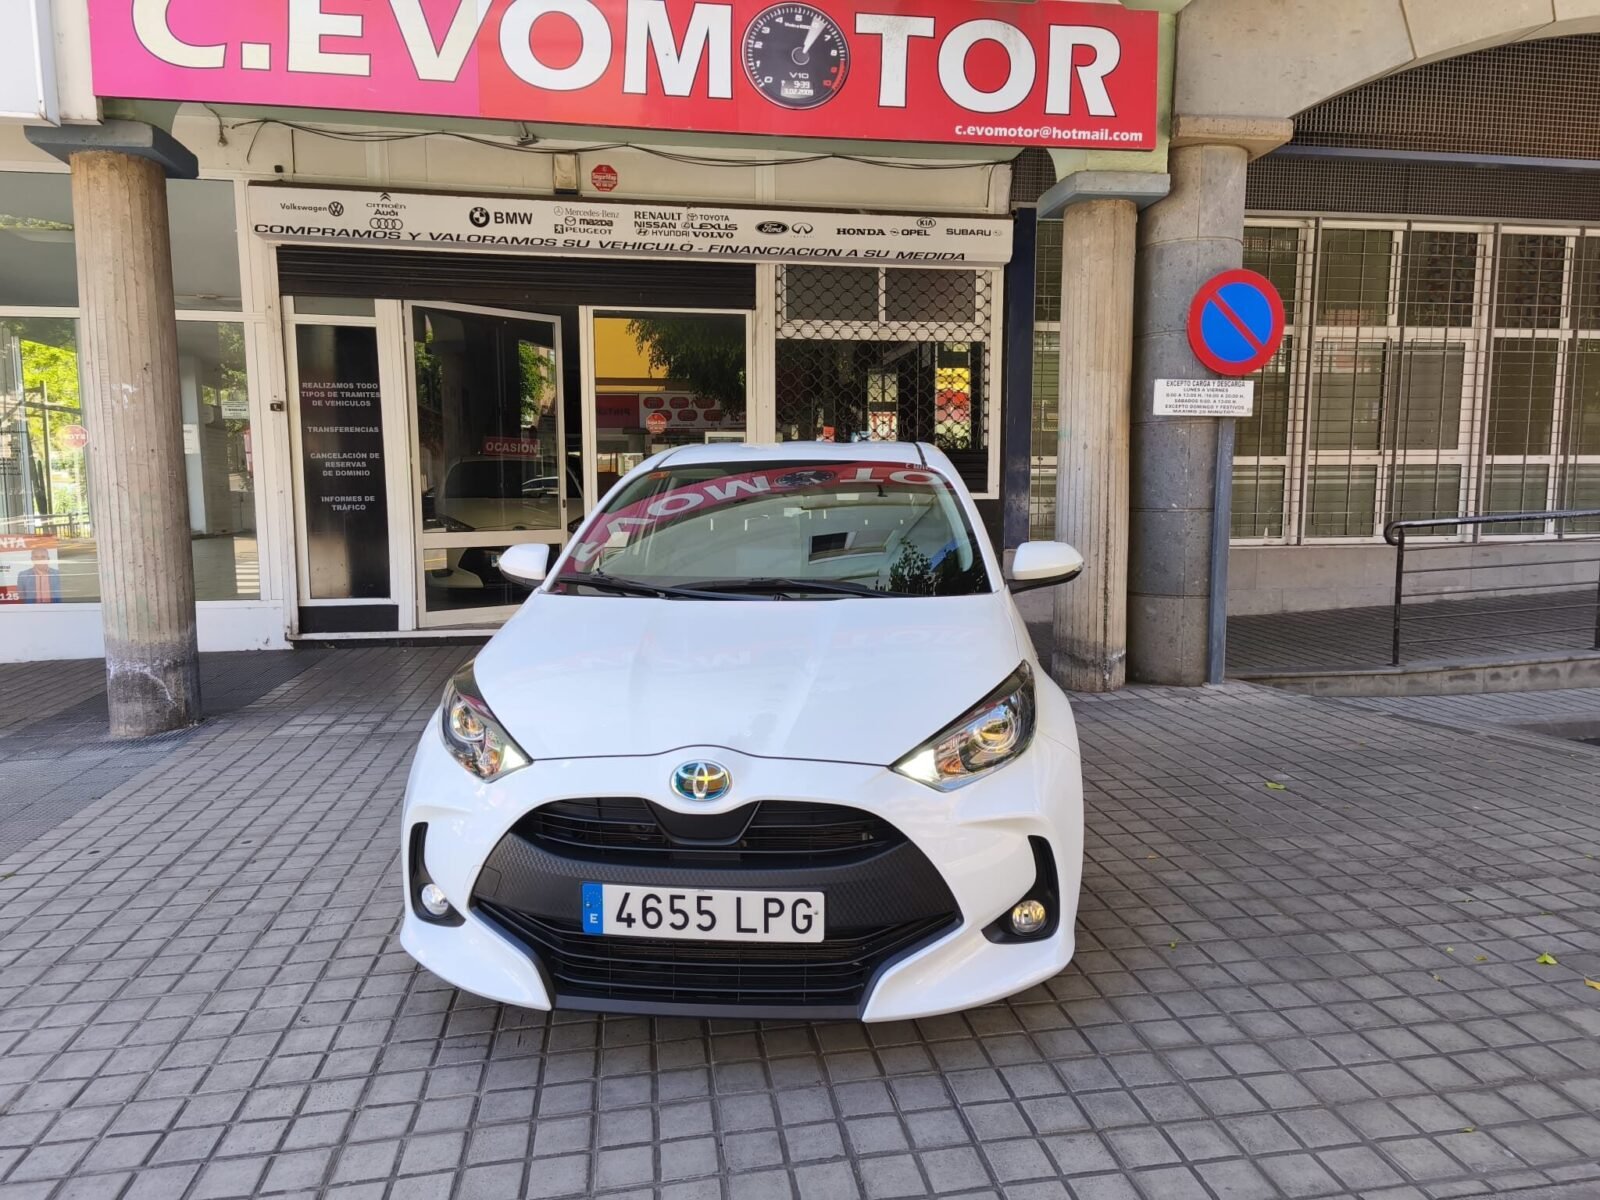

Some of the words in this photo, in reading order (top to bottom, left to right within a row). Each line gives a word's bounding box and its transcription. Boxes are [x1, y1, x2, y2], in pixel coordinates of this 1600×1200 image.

[789, 71, 809, 79] V10
[954, 124, 1143, 142] c.evomotor@hotmail.com
[280, 202, 328, 213] Volkswagen
[374, 208, 399, 217] Audi
[565, 208, 619, 218] Mercedes-Benz
[634, 211, 683, 221] RENAULT
[494, 212, 533, 225] BMW
[699, 214, 730, 222] TOYOTA
[634, 221, 677, 230] NISSAN
[690, 222, 738, 231] LEXUS
[565, 226, 612, 235] PEUGEOT
[652, 230, 690, 238] HYUNDAI
[692, 230, 734, 239] VOLVO
[836, 227, 886, 236] HONDA
[945, 228, 991, 236] SUBARU
[254, 224, 401, 240] COMPRAMOS
[408, 232, 421, 241] Y
[428, 232, 557, 247] VALORAMOS
[562, 239, 591, 248] SU
[598, 240, 694, 252] VEHICULO
[708, 245, 842, 257] FINANCIACION
[845, 249, 858, 257] A
[863, 249, 890, 258] SU
[896, 251, 966, 261] MEDIDA
[615, 891, 717, 932] 4655
[735, 896, 813, 934] LPG
[589, 913, 598, 923] E
